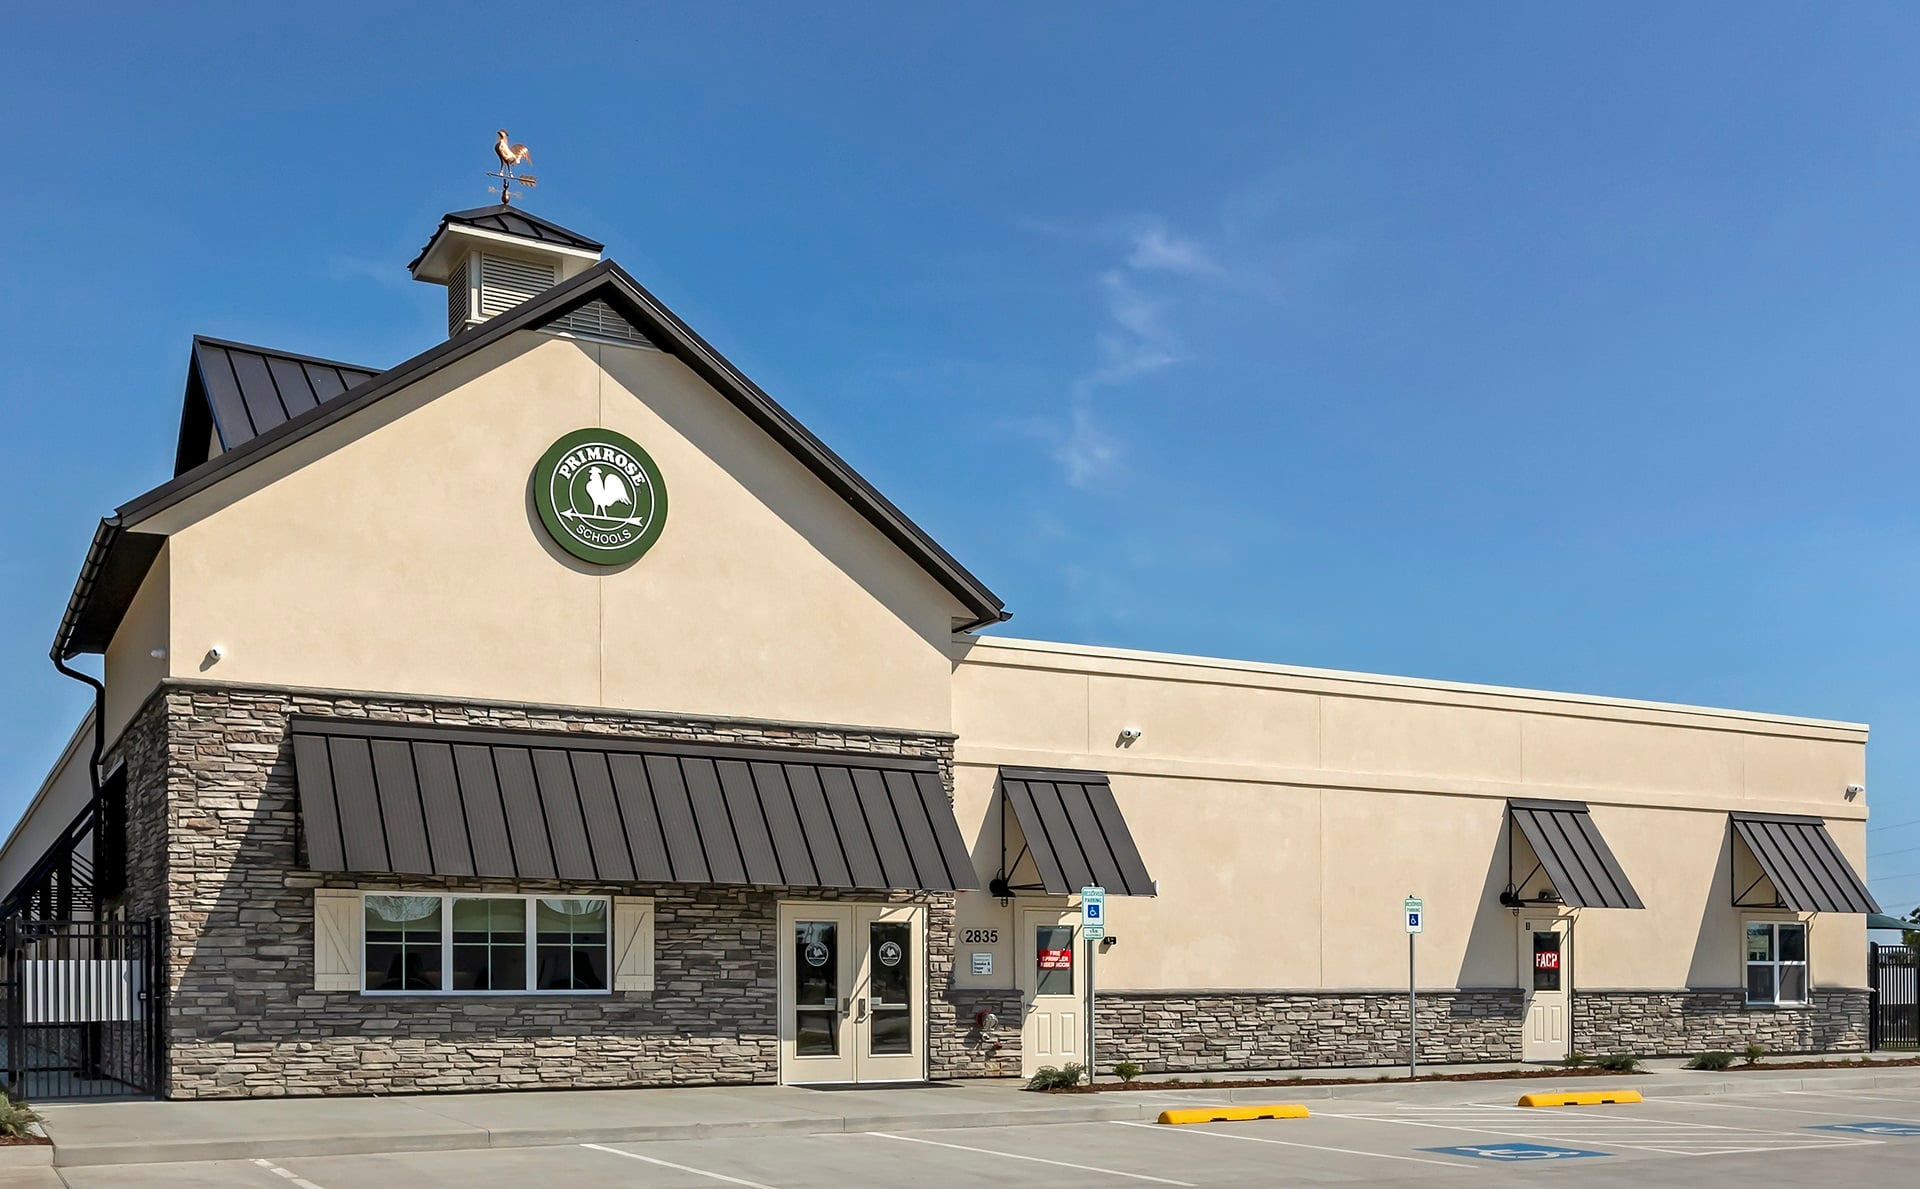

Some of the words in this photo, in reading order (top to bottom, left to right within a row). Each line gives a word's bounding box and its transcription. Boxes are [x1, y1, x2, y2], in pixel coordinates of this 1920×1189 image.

[558, 447, 646, 487] PRIMROSE
[576, 524, 632, 544] SCHOOLS
[965, 930, 998, 943] 2835
[1535, 952, 1558, 968] FACP
